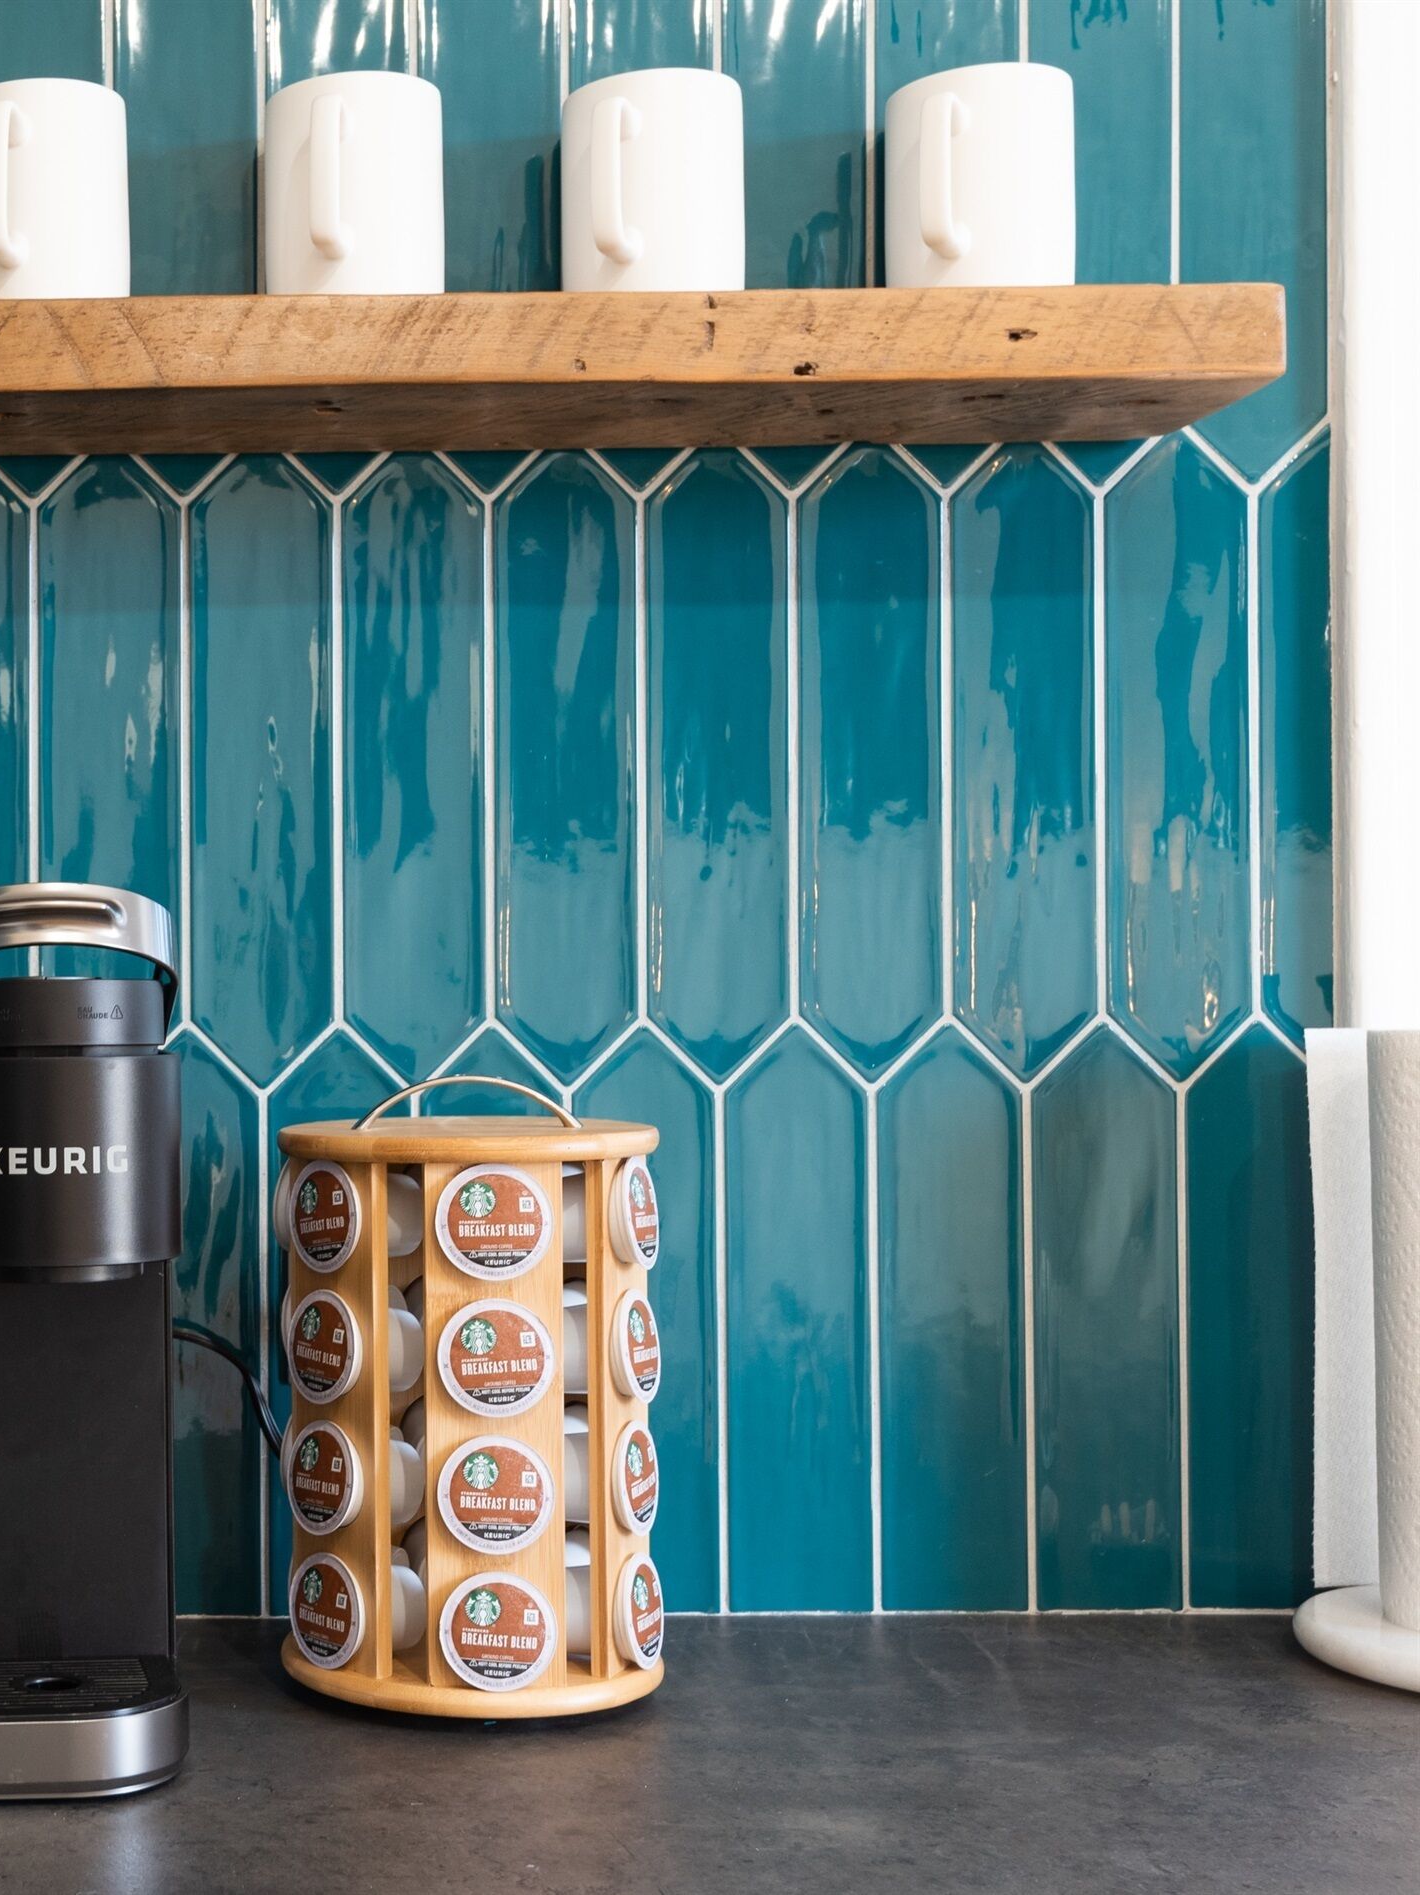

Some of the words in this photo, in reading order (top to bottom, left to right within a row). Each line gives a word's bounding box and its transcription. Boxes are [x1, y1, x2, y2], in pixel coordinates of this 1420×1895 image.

[300, 1219, 325, 1234] BREAKFAST
[326, 1216, 344, 1230] BLEND
[459, 1224, 506, 1237] BREAKFAST
[508, 1224, 535, 1236] BLEND
[296, 1344, 322, 1362] BREAKFAST
[322, 1352, 341, 1367] BLEND
[461, 1361, 508, 1376] BREAKFAST
[511, 1358, 537, 1373] BLEND
[295, 1475, 321, 1493] BREAKFAST
[321, 1481, 340, 1496] BLEND
[460, 1496, 507, 1510] BREAKFAST
[509, 1498, 536, 1511] BLEND
[299, 1607, 325, 1628] BREAKFAST
[326, 1616, 345, 1633] BLEND
[461, 1632, 508, 1647] BREAKFAST
[511, 1635, 538, 1650] BLEND
[484, 1669, 512, 1677] KEURIG
